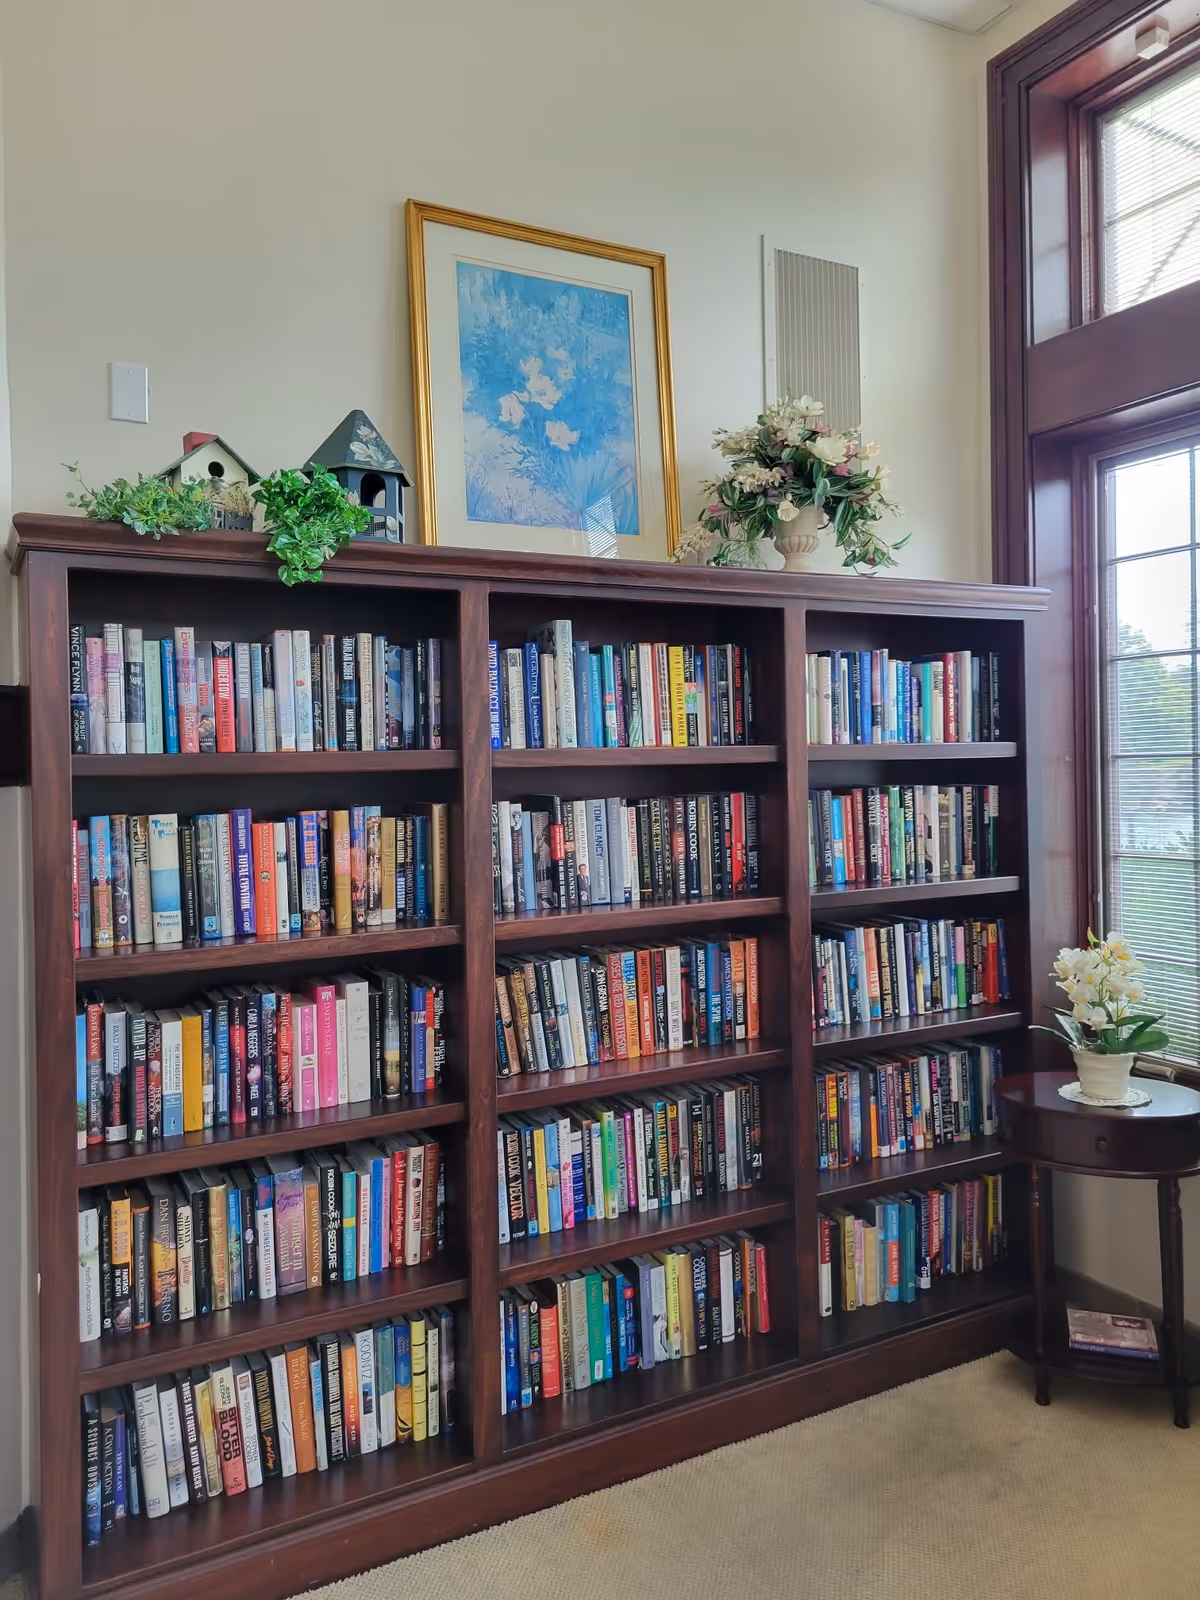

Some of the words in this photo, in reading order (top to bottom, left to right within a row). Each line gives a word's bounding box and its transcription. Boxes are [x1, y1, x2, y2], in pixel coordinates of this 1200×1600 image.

[71, 627, 79, 657] VINCE
[488, 644, 497, 667] DAVID
[72, 660, 80, 691] FLYNN
[217, 659, 230, 699] UNDERTOW
[240, 674, 249, 699] BROWN
[530, 662, 539, 693] GRAFTON
[489, 671, 498, 709] BALDACCI
[491, 722, 499, 738] GAME
[677, 713, 686, 735] PARKER
[676, 801, 684, 824] FEAR
[867, 795, 876, 827] NEVILLE
[904, 793, 913, 806] AMY
[593, 804, 602, 823] TOM
[688, 801, 697, 830] ROBIN
[905, 807, 914, 822] TAN
[97, 837, 106, 862] Kitchen
[594, 825, 604, 858] CLANCY
[690, 832, 699, 860] COOK
[714, 832, 722, 864] GRANT
[870, 843, 878, 863] CIRCLE
[222, 838, 232, 874] GRAFTON
[238, 853, 249, 875] TOTAL
[824, 850, 833, 867] HOPE
[569, 869, 577, 899] FRANKEN
[678, 854, 687, 893] WOODWARD
[239, 878, 251, 910] CONTROL
[305, 883, 313, 903] DEATH
[397, 877, 406, 909] OBSESSION
[931, 925, 940, 952] CATHERINE
[610, 956, 621, 979] ROSES
[697, 949, 706, 964] JAMES
[724, 957, 732, 979] JAMES
[733, 950, 744, 976] SAIL
[932, 952, 941, 977] COULTER
[541, 964, 550, 980] JOHN
[624, 958, 637, 1001] LIFEGUARD
[698, 964, 707, 989] PATTERSON
[750, 965, 758, 1004] PATTERSON
[544, 982, 552, 1007] GRISHAM
[612, 980, 622, 993] ARE
[712, 994, 721, 1005] THE
[725, 980, 733, 1020] PATTERSON
[613, 994, 623, 1008] RED
[712, 1006, 722, 1023] SPIRE
[736, 998, 746, 1023] PATTERSON
[884, 995, 893, 1013] PREY
[90, 1007, 100, 1036] LOVER'S
[217, 1005, 226, 1031] LAURA
[247, 1008, 257, 1029] CARLA
[91, 1038, 100, 1055] LANE
[133, 1019, 147, 1061] COVER-UP
[248, 1029, 259, 1059] NEGGERS
[614, 1014, 626, 1054] PATTERSON
[218, 1034, 227, 1070] LIPPMAN
[497, 1037, 508, 1064] GRISHAM
[525, 1041, 534, 1062] GRISHAM
[91, 1065, 99, 1076] Jill
[90, 1078, 99, 1097] Marie
[91, 1099, 100, 1121] Landis
[136, 1093, 147, 1128] MARTINEZ
[905, 1095, 913, 1118] WOODS
[933, 1105, 941, 1135] SCOTTOLINE
[656, 1109, 666, 1133] JANET
[506, 1133, 518, 1156] ROBIN
[657, 1134, 669, 1176] EVANOVICH
[327, 1168, 335, 1191] ROBIN
[508, 1156, 521, 1177] COOK
[159, 1198, 168, 1221] DAN
[312, 1200, 320, 1227] EMPTY
[328, 1191, 336, 1211] COOK
[510, 1180, 524, 1221] VECTOR
[931, 1193, 940, 1220] PATRICIA
[327, 1229, 338, 1269] SEIZURE
[932, 1221, 941, 1253] CORNWELL
[262, 1220, 272, 1285] MISUNDERESTIMATED
[85, 1266, 93, 1282] North
[693, 1258, 702, 1292] COULTER
[699, 1256, 707, 1289] CATHERINE
[86, 1283, 94, 1311] American
[114, 1278, 122, 1297] DEATH
[138, 1279, 146, 1313] KINGSBURY
[157, 1267, 176, 1322] INFERNO
[698, 1302, 706, 1338] WHIPLASH
[530, 1323, 542, 1347] ANDREWS
[299, 1356, 307, 1376] BACK
[326, 1342, 339, 1370] PATRICIA
[360, 1338, 373, 1381] KOONTZ
[508, 1347, 516, 1367] gravity
[254, 1370, 270, 1400] PATRICIA
[291, 1358, 301, 1390] BLOOD
[327, 1370, 341, 1402] CORNWELL
[532, 1363, 540, 1384] CELESTE
[181, 1382, 191, 1403] BONES
[219, 1377, 228, 1406] BLEDSOE
[166, 1402, 174, 1429] SANDRA
[184, 1403, 192, 1415] ARE
[244, 1401, 253, 1428] DISCIPLE
[257, 1400, 274, 1431] CORNWELL
[297, 1400, 306, 1419] Tom
[330, 1401, 341, 1412] THE
[330, 1413, 343, 1427] LAST
[136, 1393, 156, 1454] Bridesmaids
[185, 1415, 198, 1443] FOREVER
[218, 1410, 233, 1460] BLOOD
[228, 1405, 241, 1458] BITTER
[299, 1422, 309, 1442] Wolfe
[88, 1427, 97, 1462] SCIENCE
[104, 1433, 114, 1458] CIVIL
[244, 1436, 252, 1464] COONTS
[251, 1433, 259, 1461] STEPHEN
[331, 1427, 345, 1456] PRECINCT
[190, 1445, 201, 1466] KATHY
[104, 1460, 113, 1494] ACTION
[192, 1466, 202, 1488] REICHS
